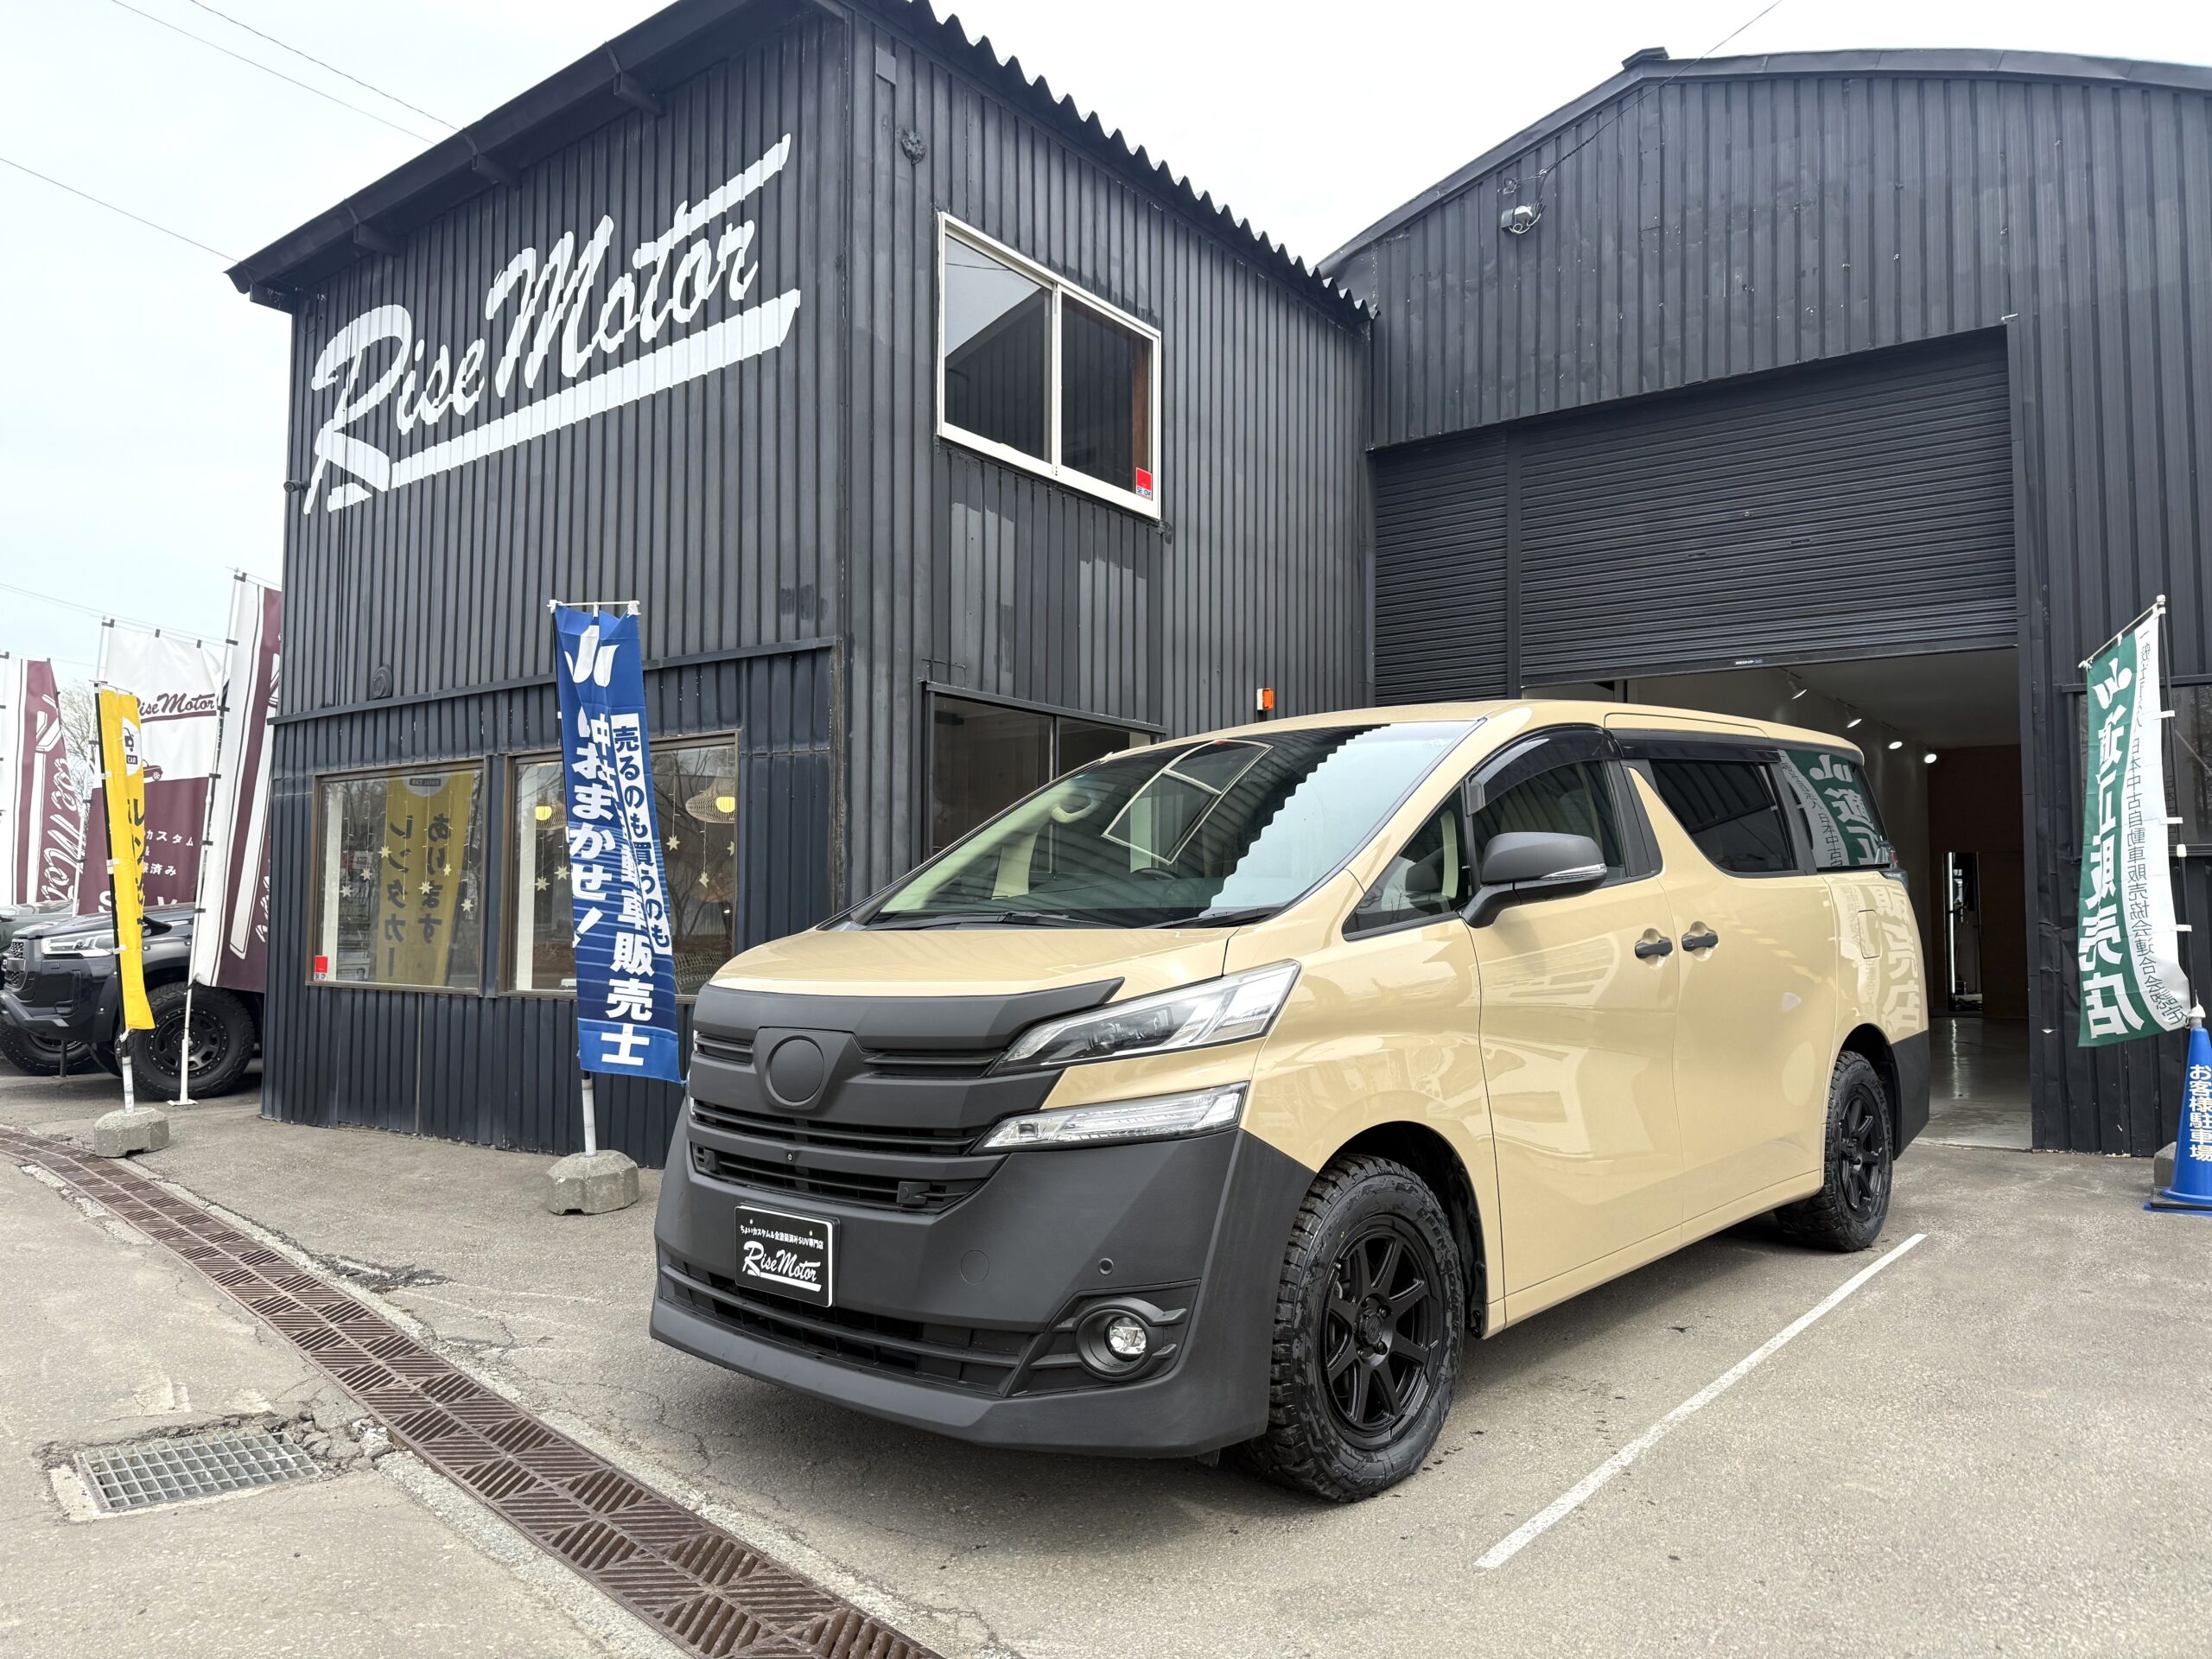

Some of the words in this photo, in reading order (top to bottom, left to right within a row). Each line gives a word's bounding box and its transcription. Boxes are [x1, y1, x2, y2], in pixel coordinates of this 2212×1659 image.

[303, 305, 486, 515] Rise
[485, 133, 791, 399] Motor
[136, 696, 160, 716] ise
[156, 693, 216, 714] Motor
[145, 829, 194, 847] カスタム
[613, 726, 671, 948] 売るのも買うのも
[2189, 1064, 2212, 1162] お客様駐車場
[741, 1241, 778, 1277] Rise
[776, 1249, 822, 1282] Motor
